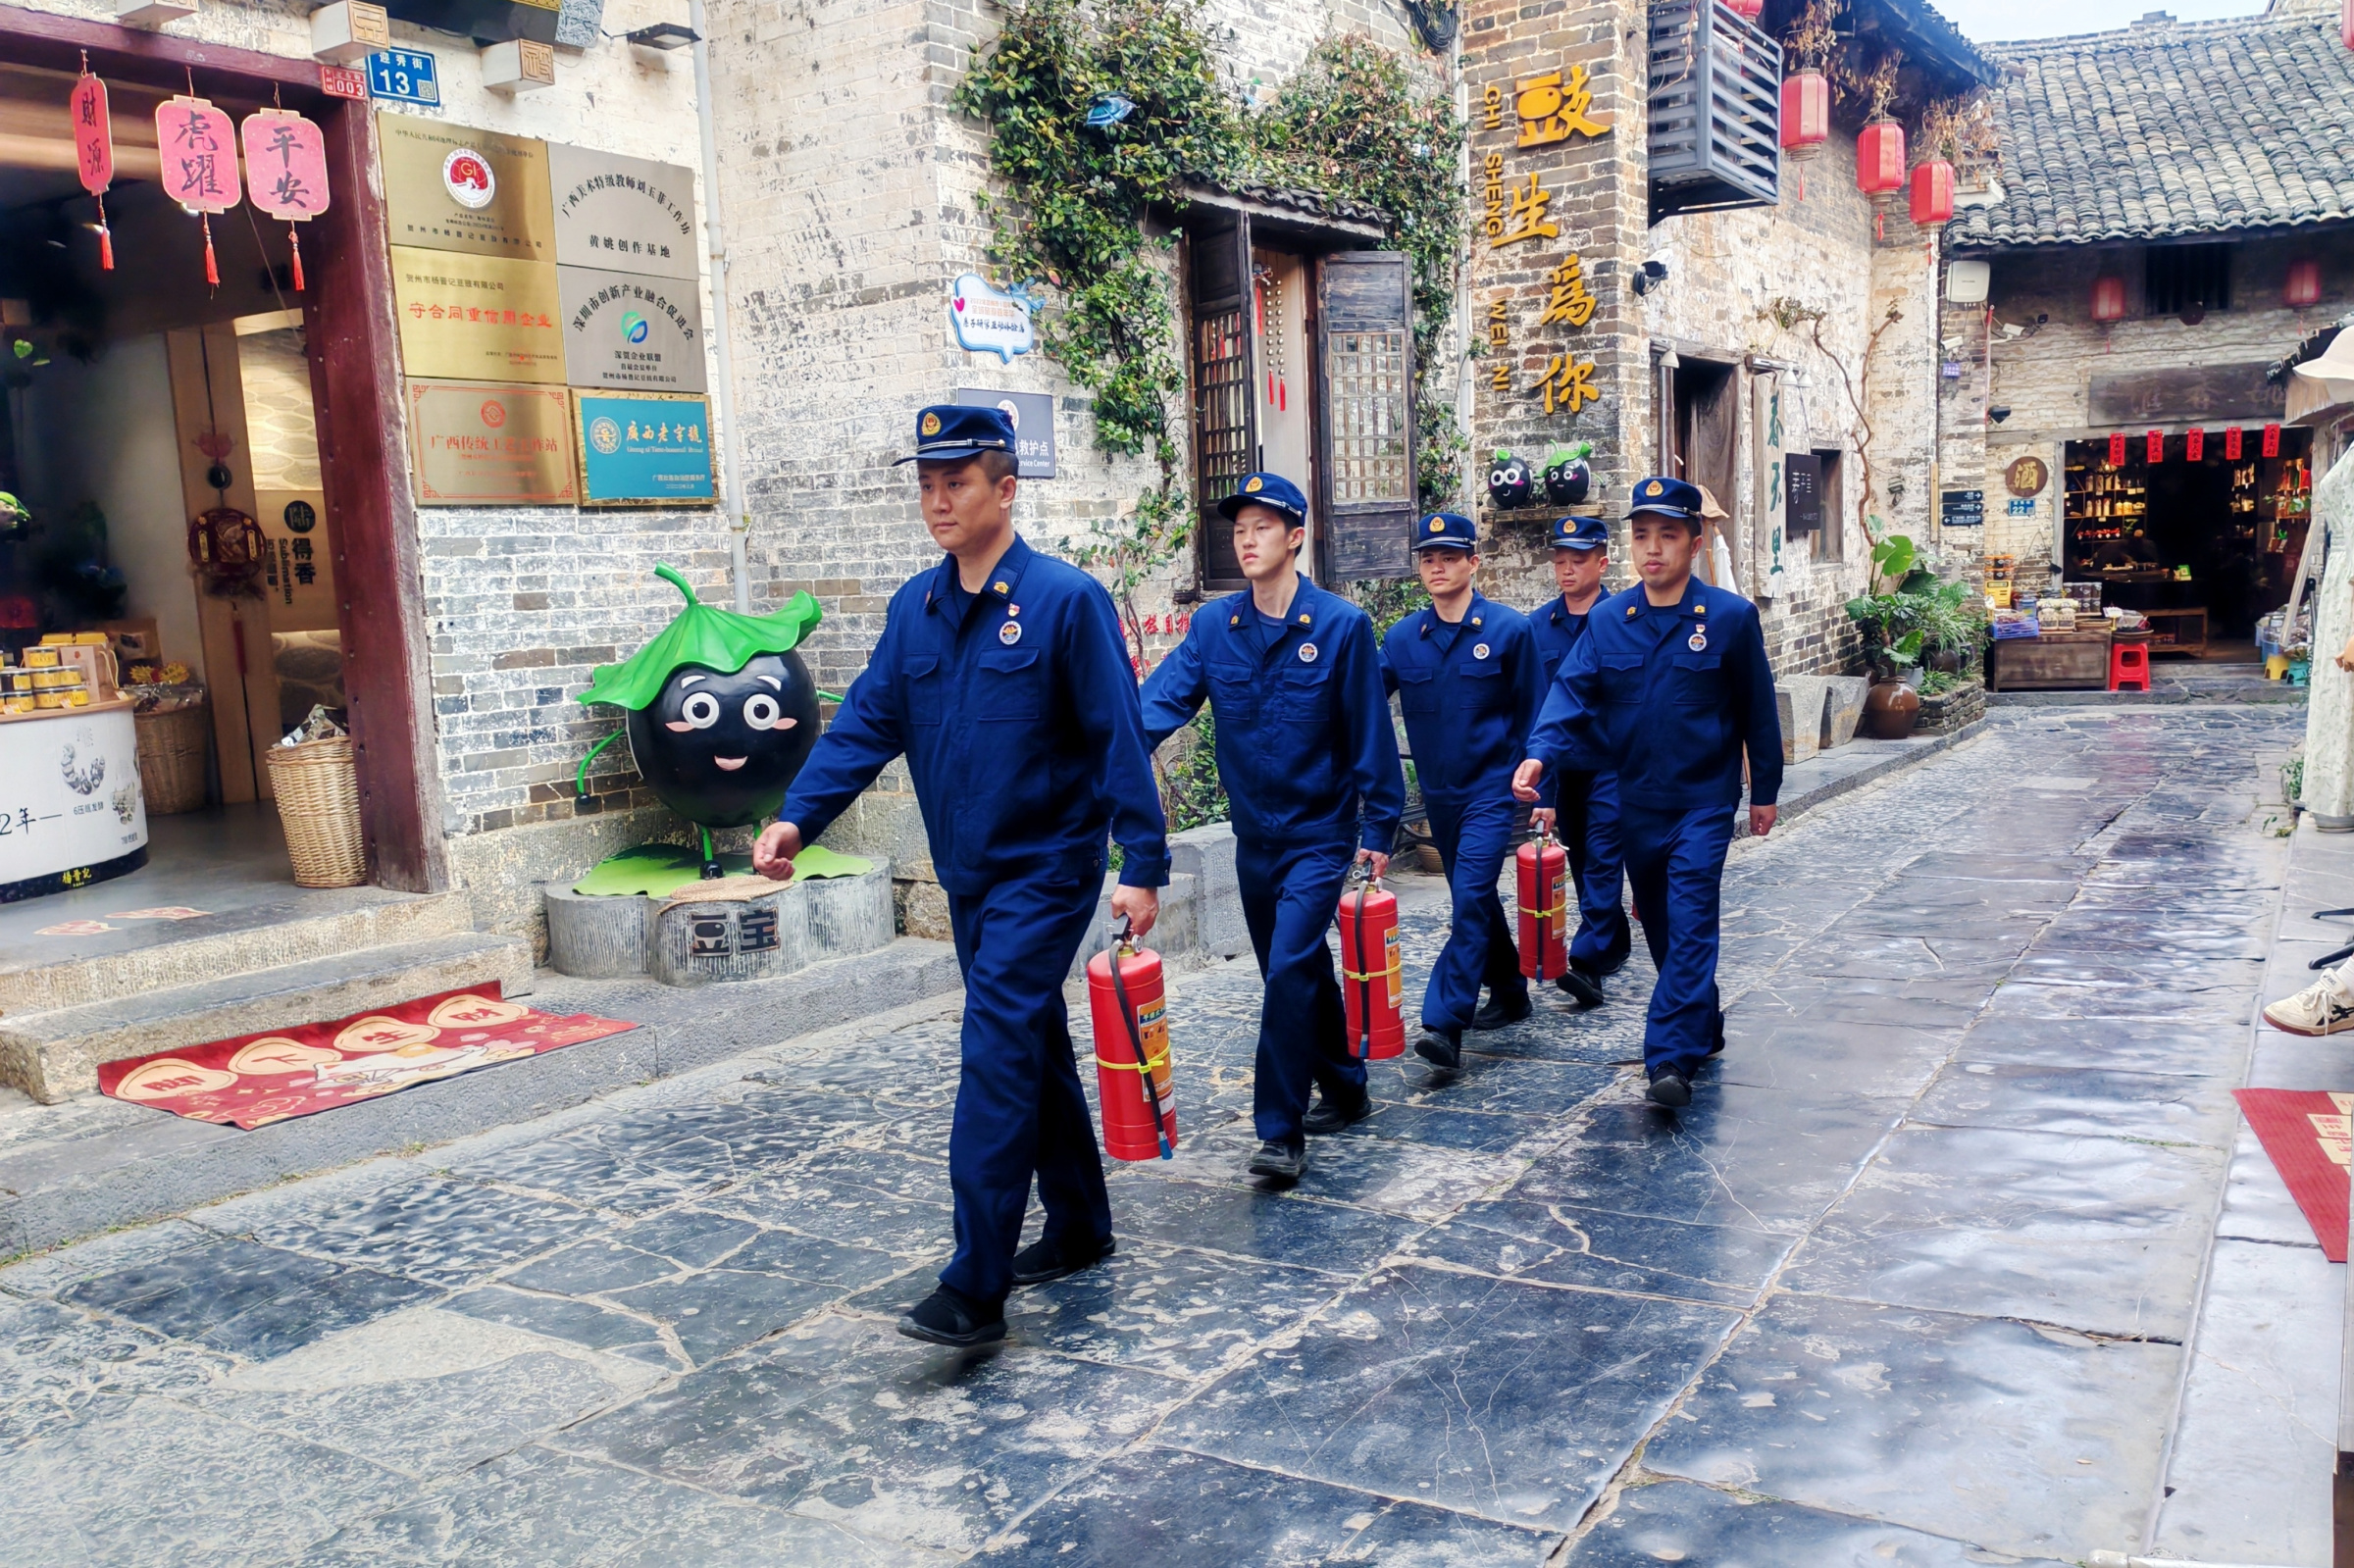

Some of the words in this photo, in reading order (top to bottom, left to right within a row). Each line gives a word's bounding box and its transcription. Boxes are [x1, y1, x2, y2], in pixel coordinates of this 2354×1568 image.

[379, 51, 423, 71] 迎秀街
[336, 79, 364, 96] 003
[380, 69, 410, 95] 13
[1483, 85, 1502, 129] CHI
[265, 126, 310, 208] 平安
[460, 162, 478, 177] GI
[1483, 152, 1504, 237] SHENG
[588, 234, 672, 259] 黄姚创作基地
[408, 301, 553, 329] 守合同重信用企业
[572, 282, 694, 341] 深圳市创新产业融合促进会
[1488, 296, 1510, 346] WEI
[962, 316, 1026, 334] 亲子研学互动体验店
[1492, 365, 1510, 391] NI
[430, 434, 559, 453] 广西传统工艺工作站
[1015, 438, 1049, 457] 救护点
[1033, 459, 1050, 468] Center
[2014, 460, 2039, 490] 酒
[2012, 506, 2025, 515] 22
